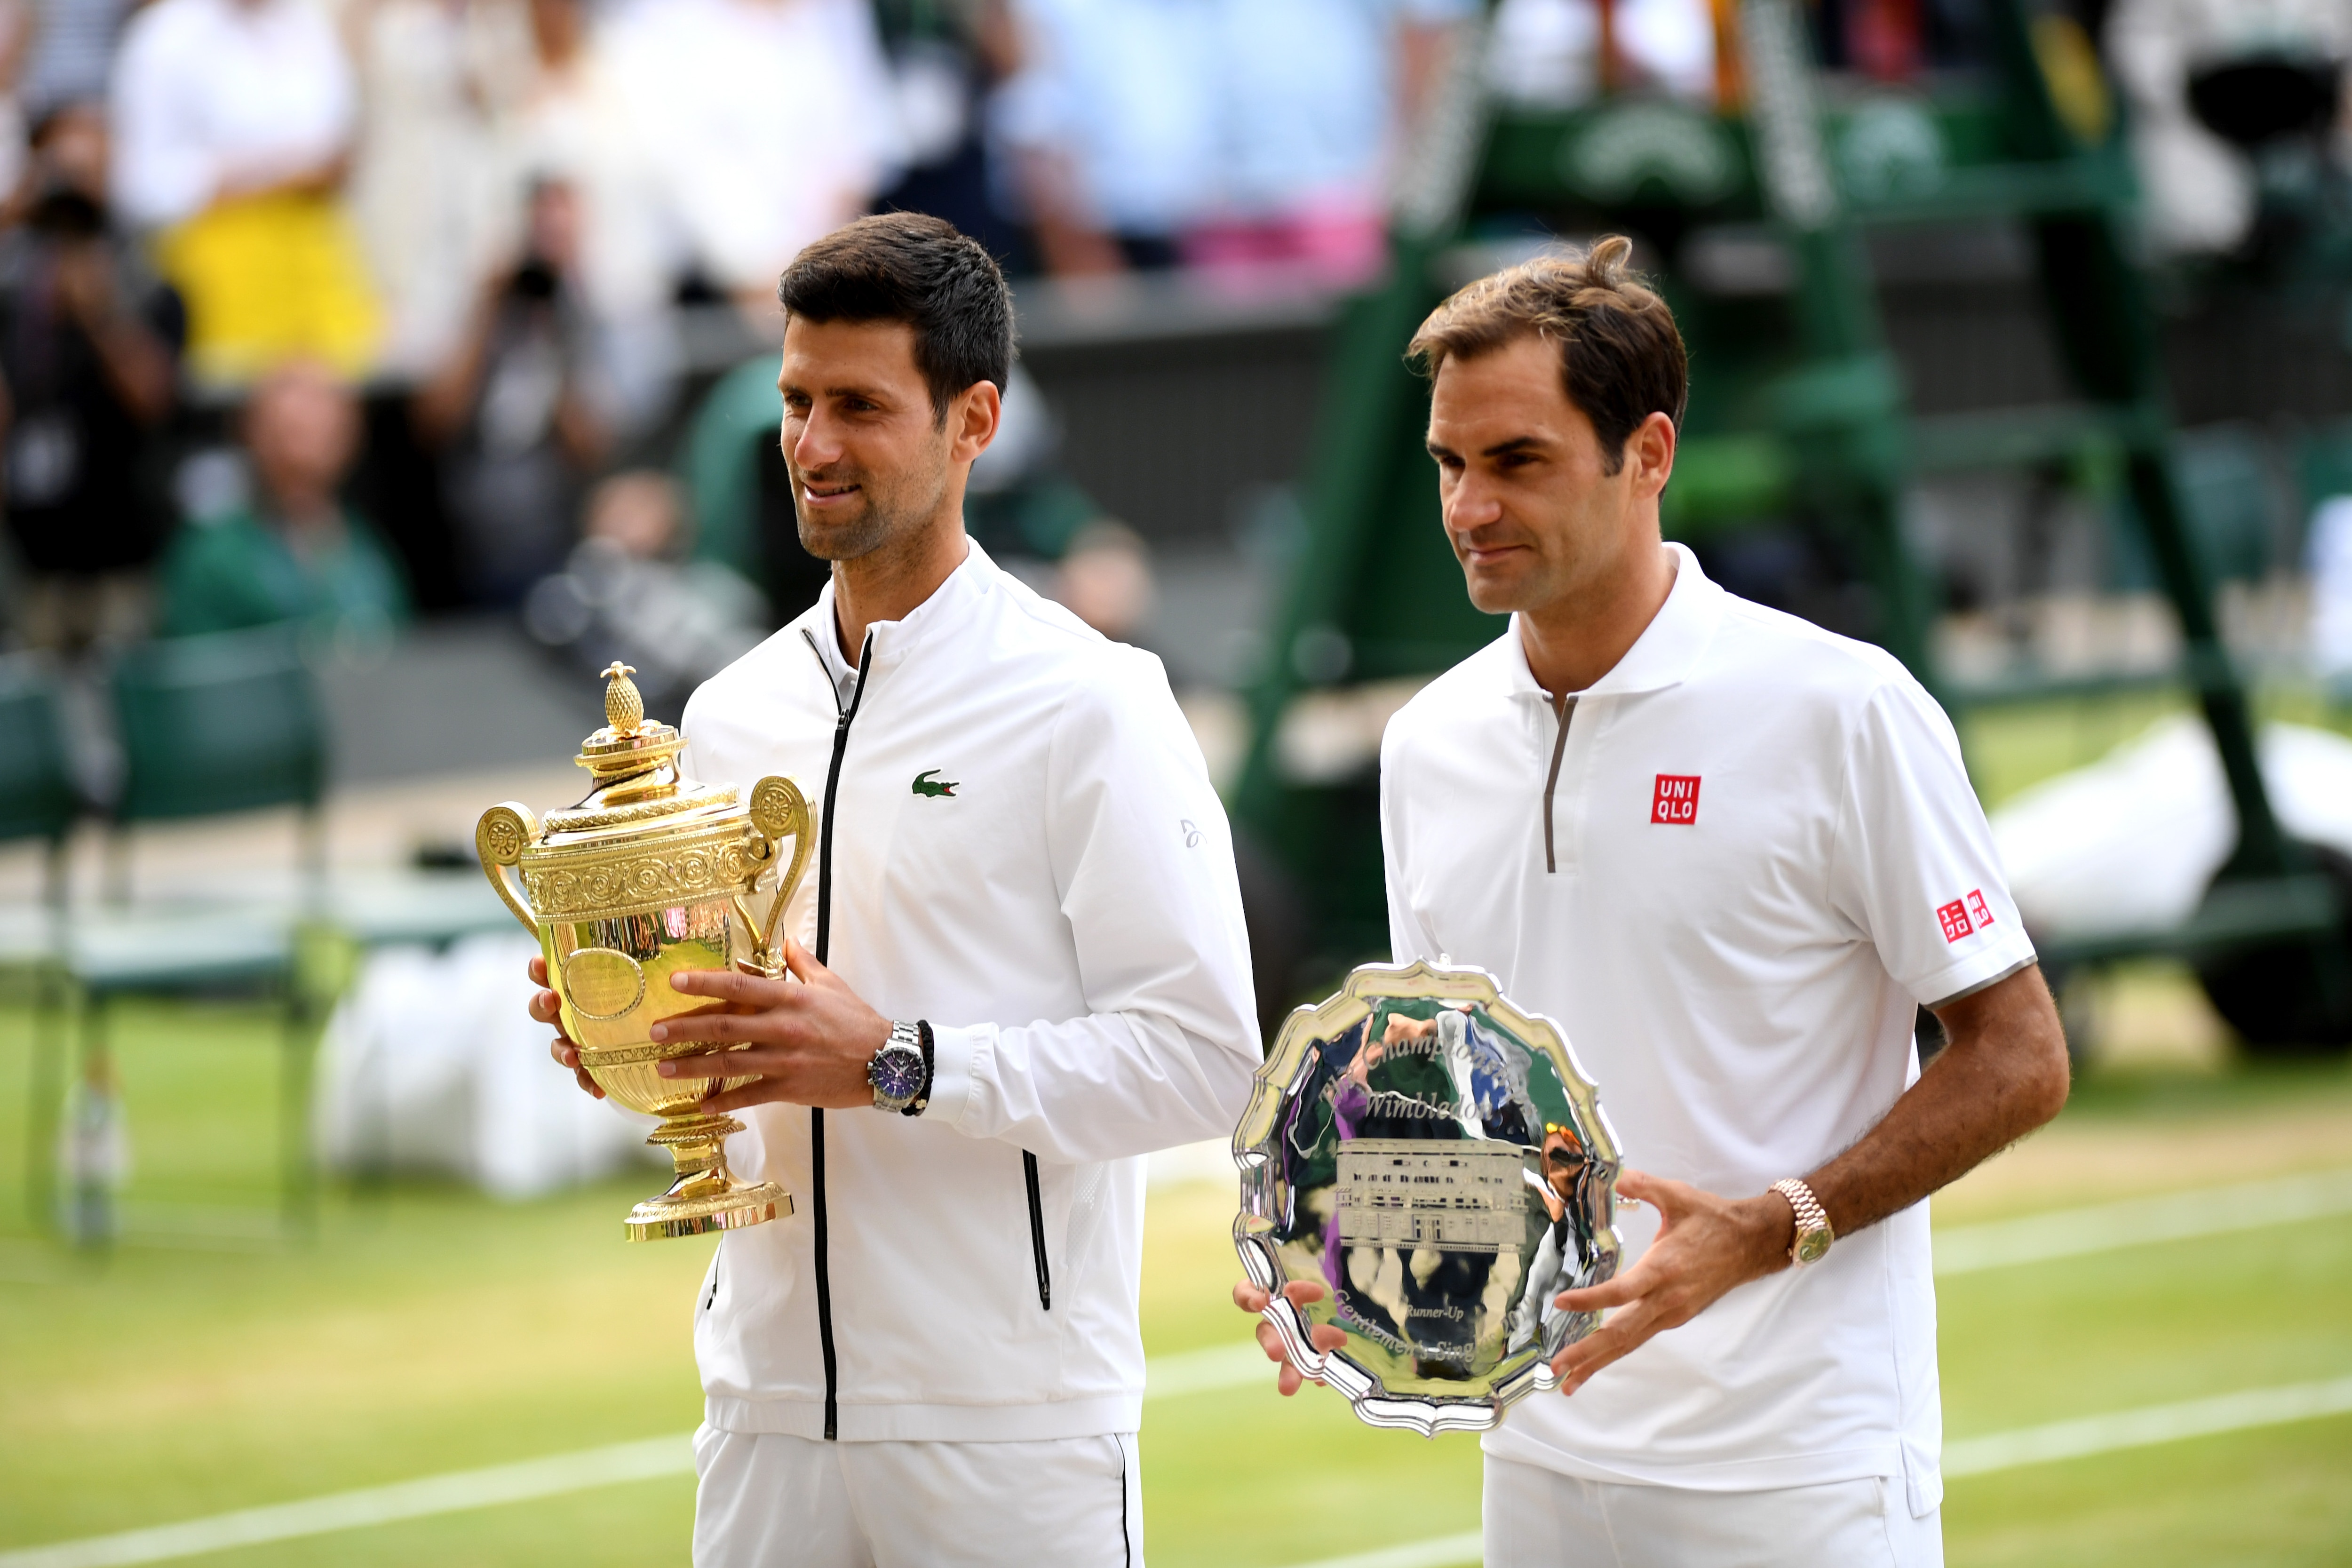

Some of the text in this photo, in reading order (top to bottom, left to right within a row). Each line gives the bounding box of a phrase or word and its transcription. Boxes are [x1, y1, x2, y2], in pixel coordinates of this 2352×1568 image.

[1660, 780, 1693, 798] UNI
[1657, 800, 1692, 821] QLO
[1318, 1066, 1356, 1113] The
[1366, 1090, 1493, 1121] Wimbledon
[1407, 1304, 1464, 1322] Runner-Up
